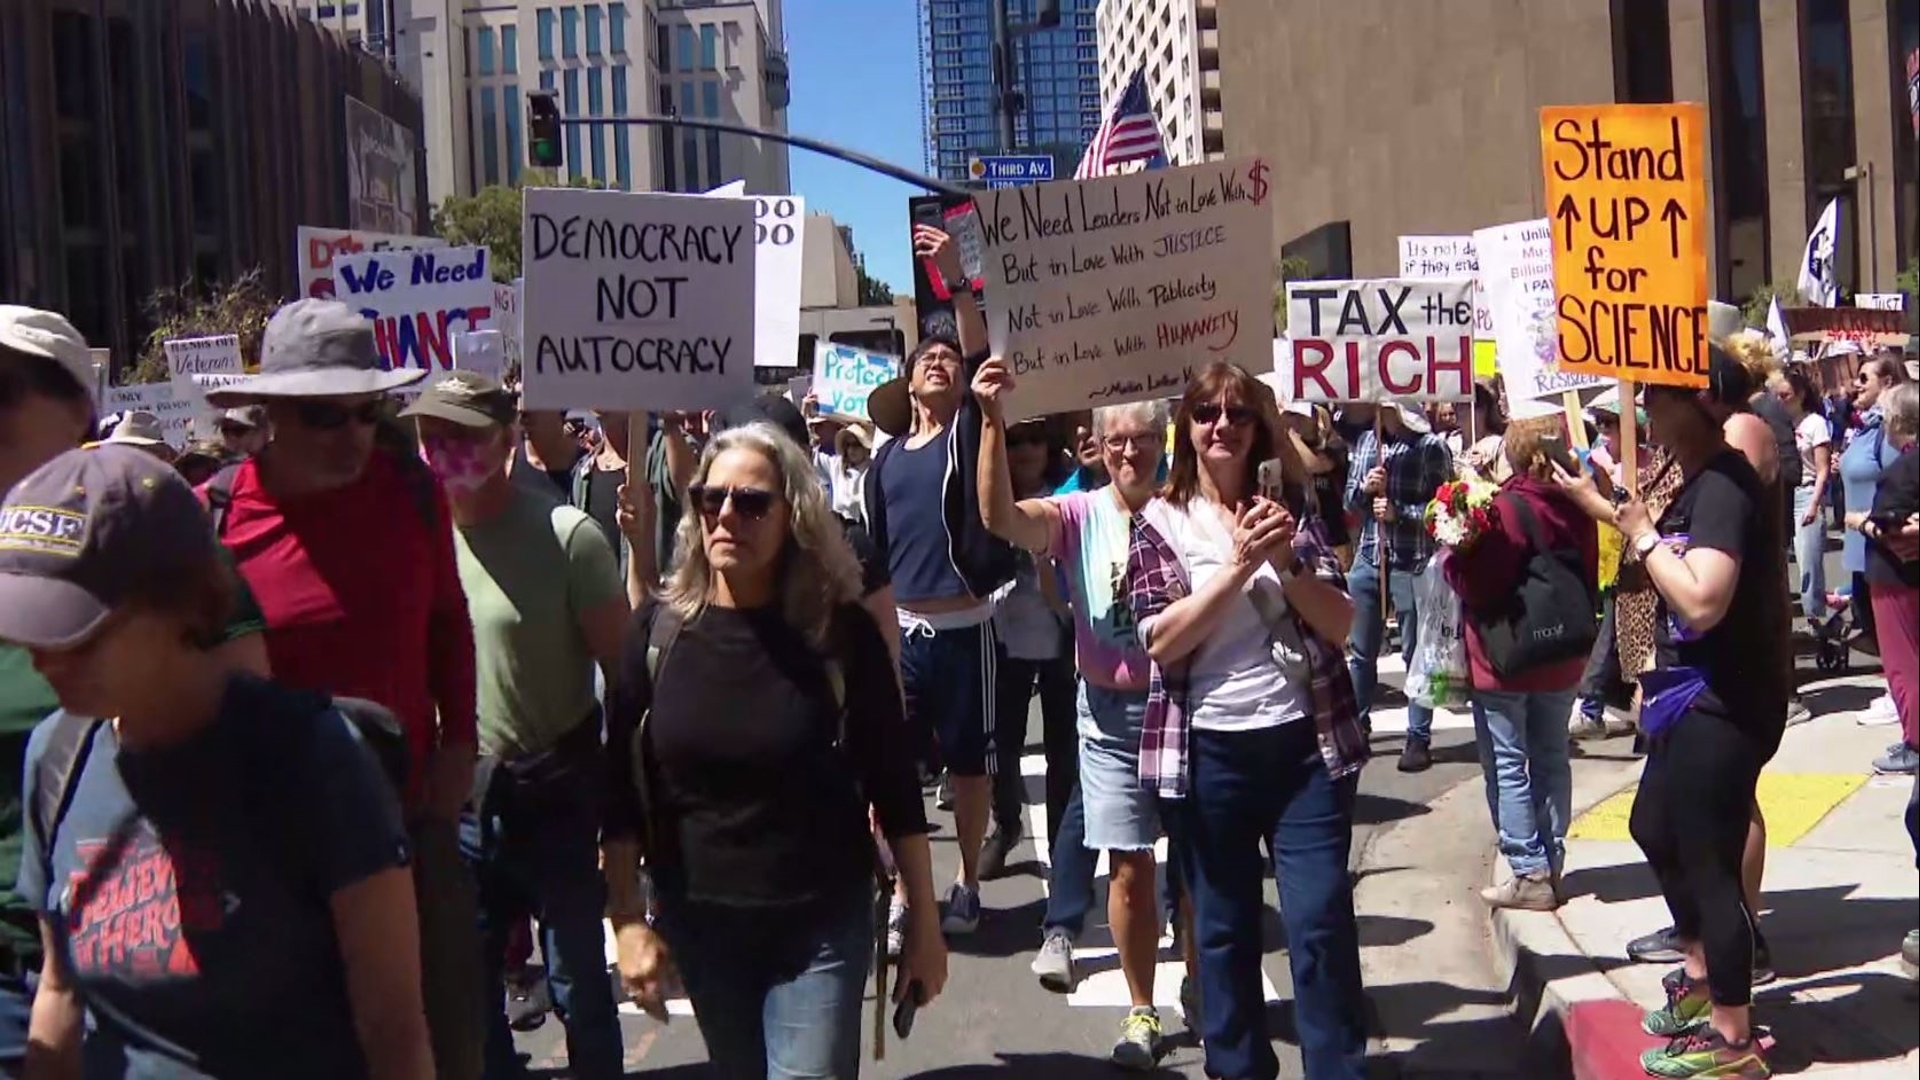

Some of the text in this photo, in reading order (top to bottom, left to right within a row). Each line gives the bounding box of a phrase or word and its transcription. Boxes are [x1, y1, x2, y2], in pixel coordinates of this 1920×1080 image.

[1554, 116, 1684, 182] Stand
[971, 190, 1018, 247] We
[1020, 184, 1074, 241] Need
[1079, 184, 1140, 232] Leaders
[1145, 176, 1171, 221] Not
[1176, 197, 1189, 215] in
[1190, 174, 1217, 214] Love
[1219, 168, 1246, 204] With
[530, 213, 743, 265] DEMOCRACY
[1002, 225, 1227, 284] But in Love With JUSTICE
[340, 257, 395, 295] We
[410, 248, 485, 287] Need
[1421, 259, 1450, 278] they
[1584, 245, 1648, 292] for
[596, 274, 689, 322] NOT
[1009, 302, 1043, 333] Not
[1048, 310, 1065, 324] in
[1066, 293, 1101, 320] Love
[1106, 286, 1142, 313] With
[1291, 286, 1471, 337] TAX the
[536, 333, 732, 375] AUTOCRACY
[1013, 308, 1238, 376] But in Love With HUMANITY
[1558, 294, 1708, 375] SCIENCE
[1292, 335, 1472, 400] RICH
